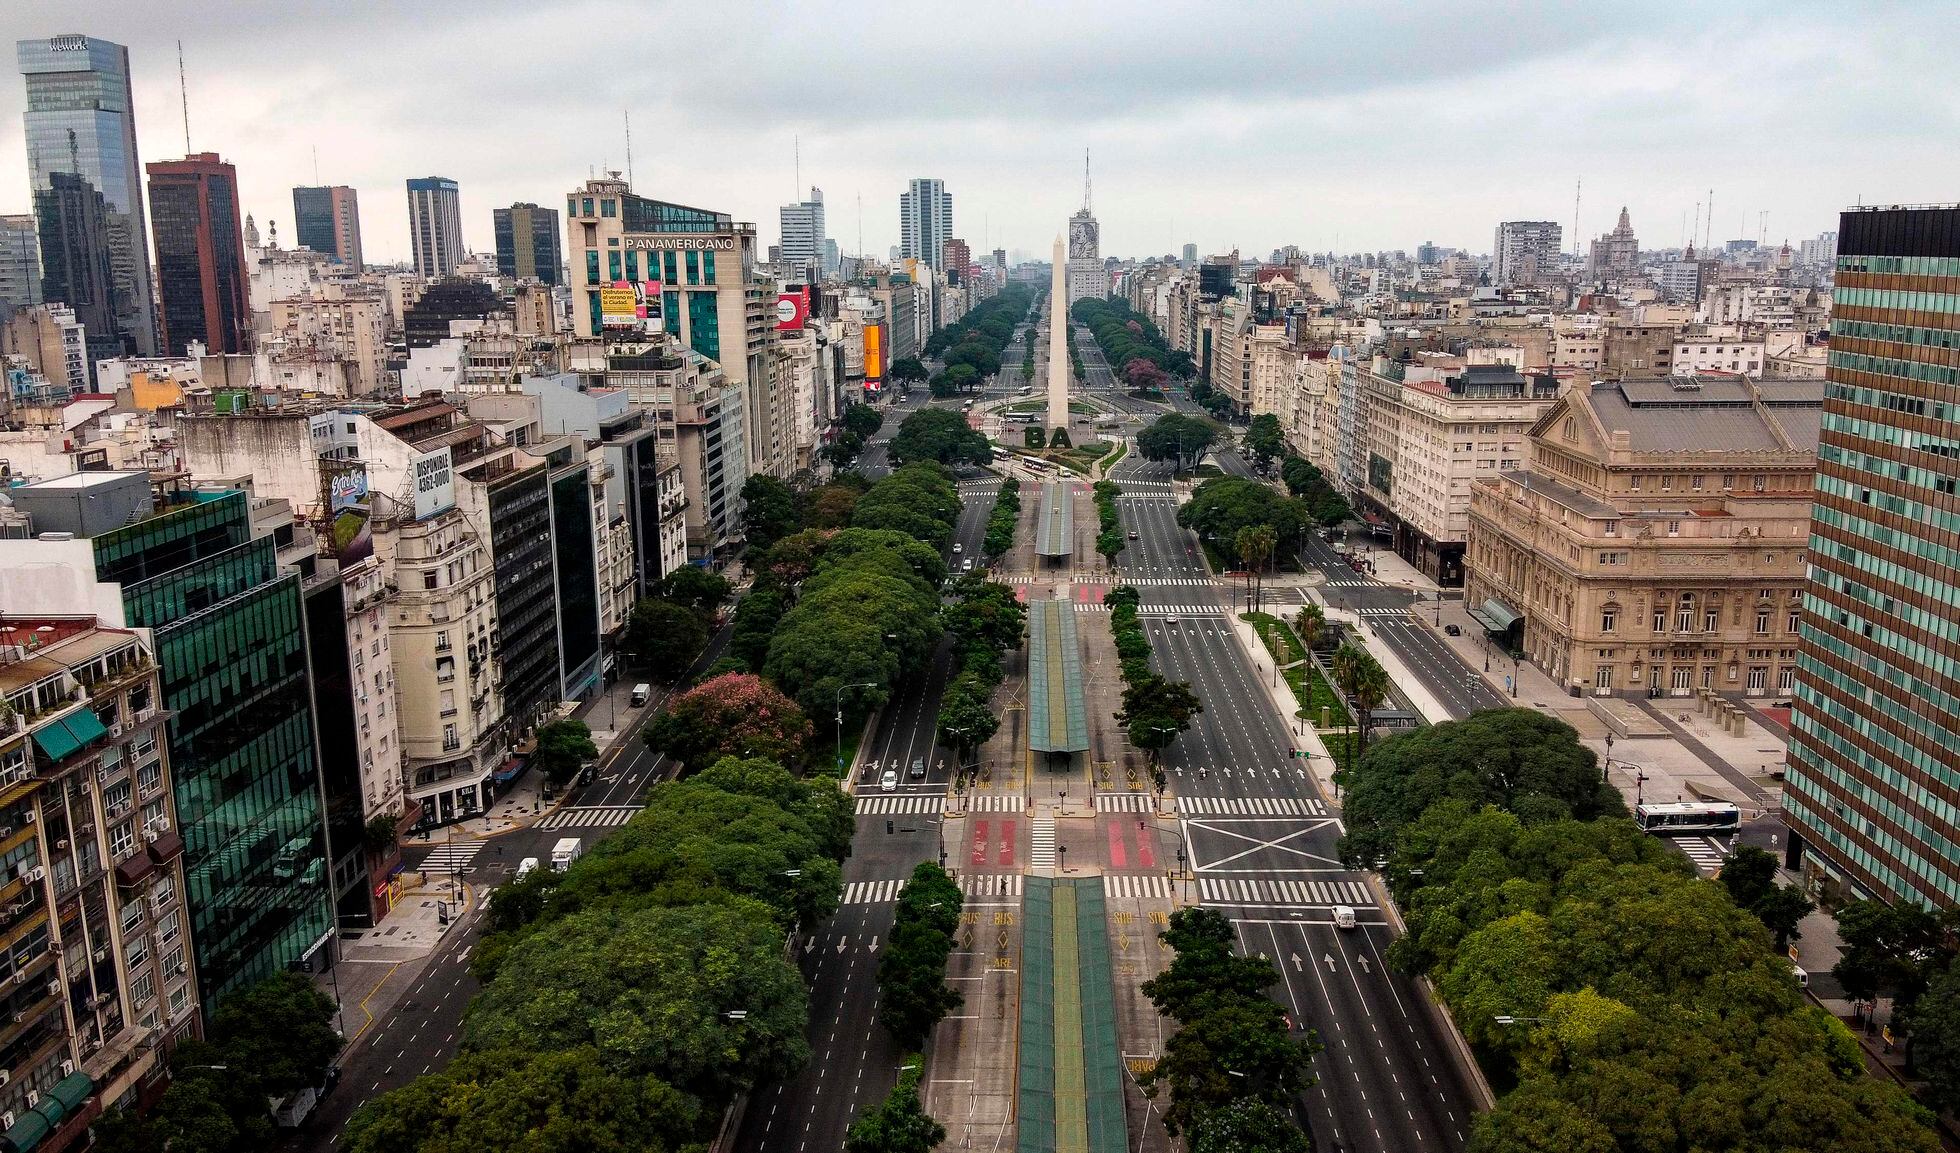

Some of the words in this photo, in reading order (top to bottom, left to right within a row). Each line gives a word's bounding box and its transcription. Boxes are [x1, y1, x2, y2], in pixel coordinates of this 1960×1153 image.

[50, 40, 88, 51] wework
[626, 239, 734, 249] PANAMERICANO
[416, 453, 448, 478] DISPONIBLE
[994, 912, 1014, 926] BUS
